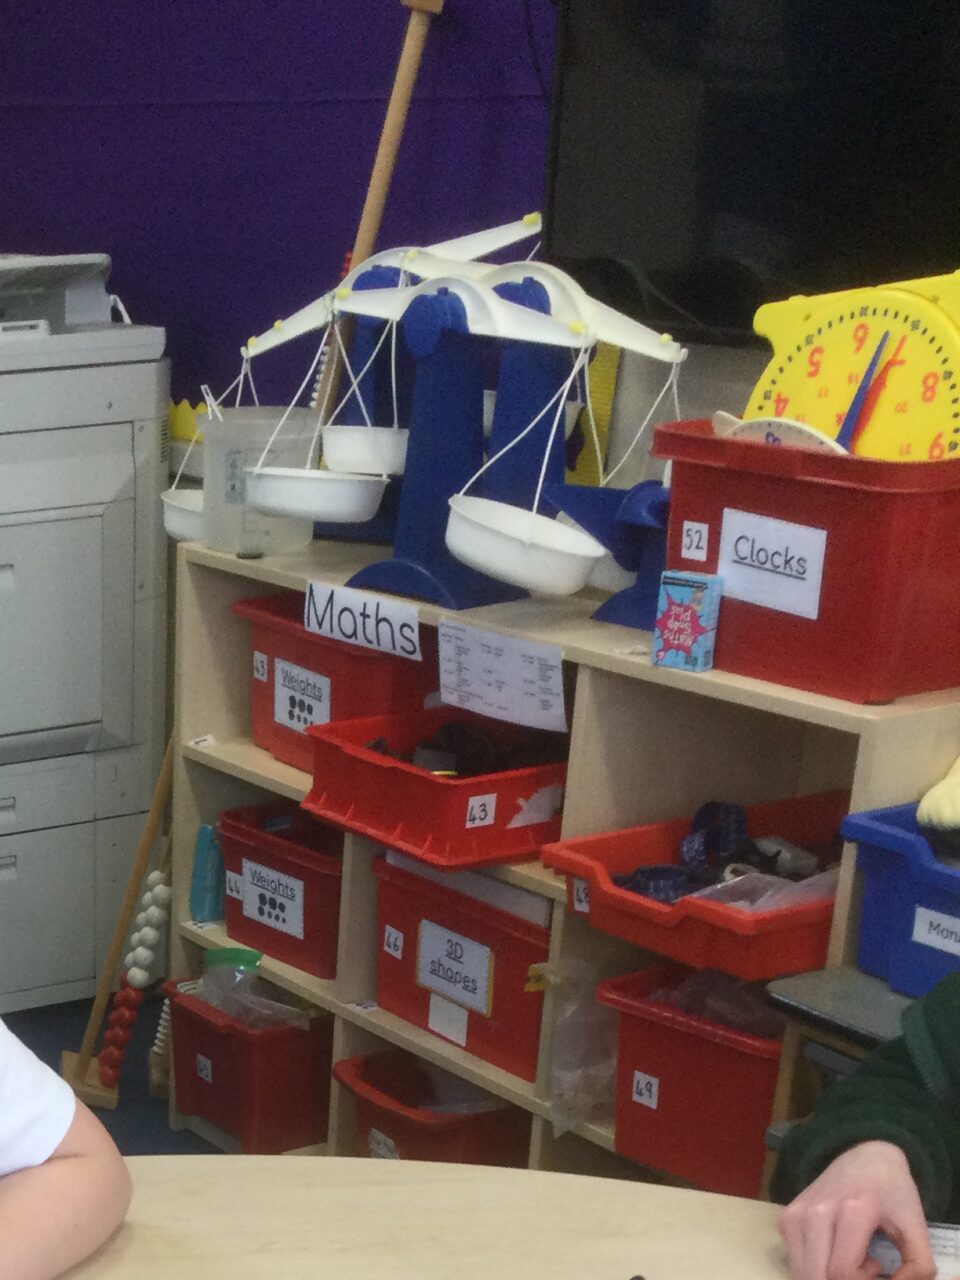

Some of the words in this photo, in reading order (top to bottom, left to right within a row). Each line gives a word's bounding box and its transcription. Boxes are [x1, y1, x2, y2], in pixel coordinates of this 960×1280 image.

[852, 323, 869, 353] 6
[806, 346, 825, 378] 5
[921, 372, 940, 403] 8
[774, 391, 789, 417] 4
[928, 431, 944, 461] 9
[684, 528, 704, 551] 52
[734, 535, 808, 578] Clocks
[306, 583, 418, 656] Maths
[254, 660, 265, 677] 43
[281, 667, 324, 700] Weights
[468, 803, 488, 825] 43
[250, 867, 296, 899] Weights
[386, 931, 401, 953] 46
[446, 939, 464, 960] 3D
[430, 958, 478, 993] shapes
[635, 1079, 654, 1099] 49
